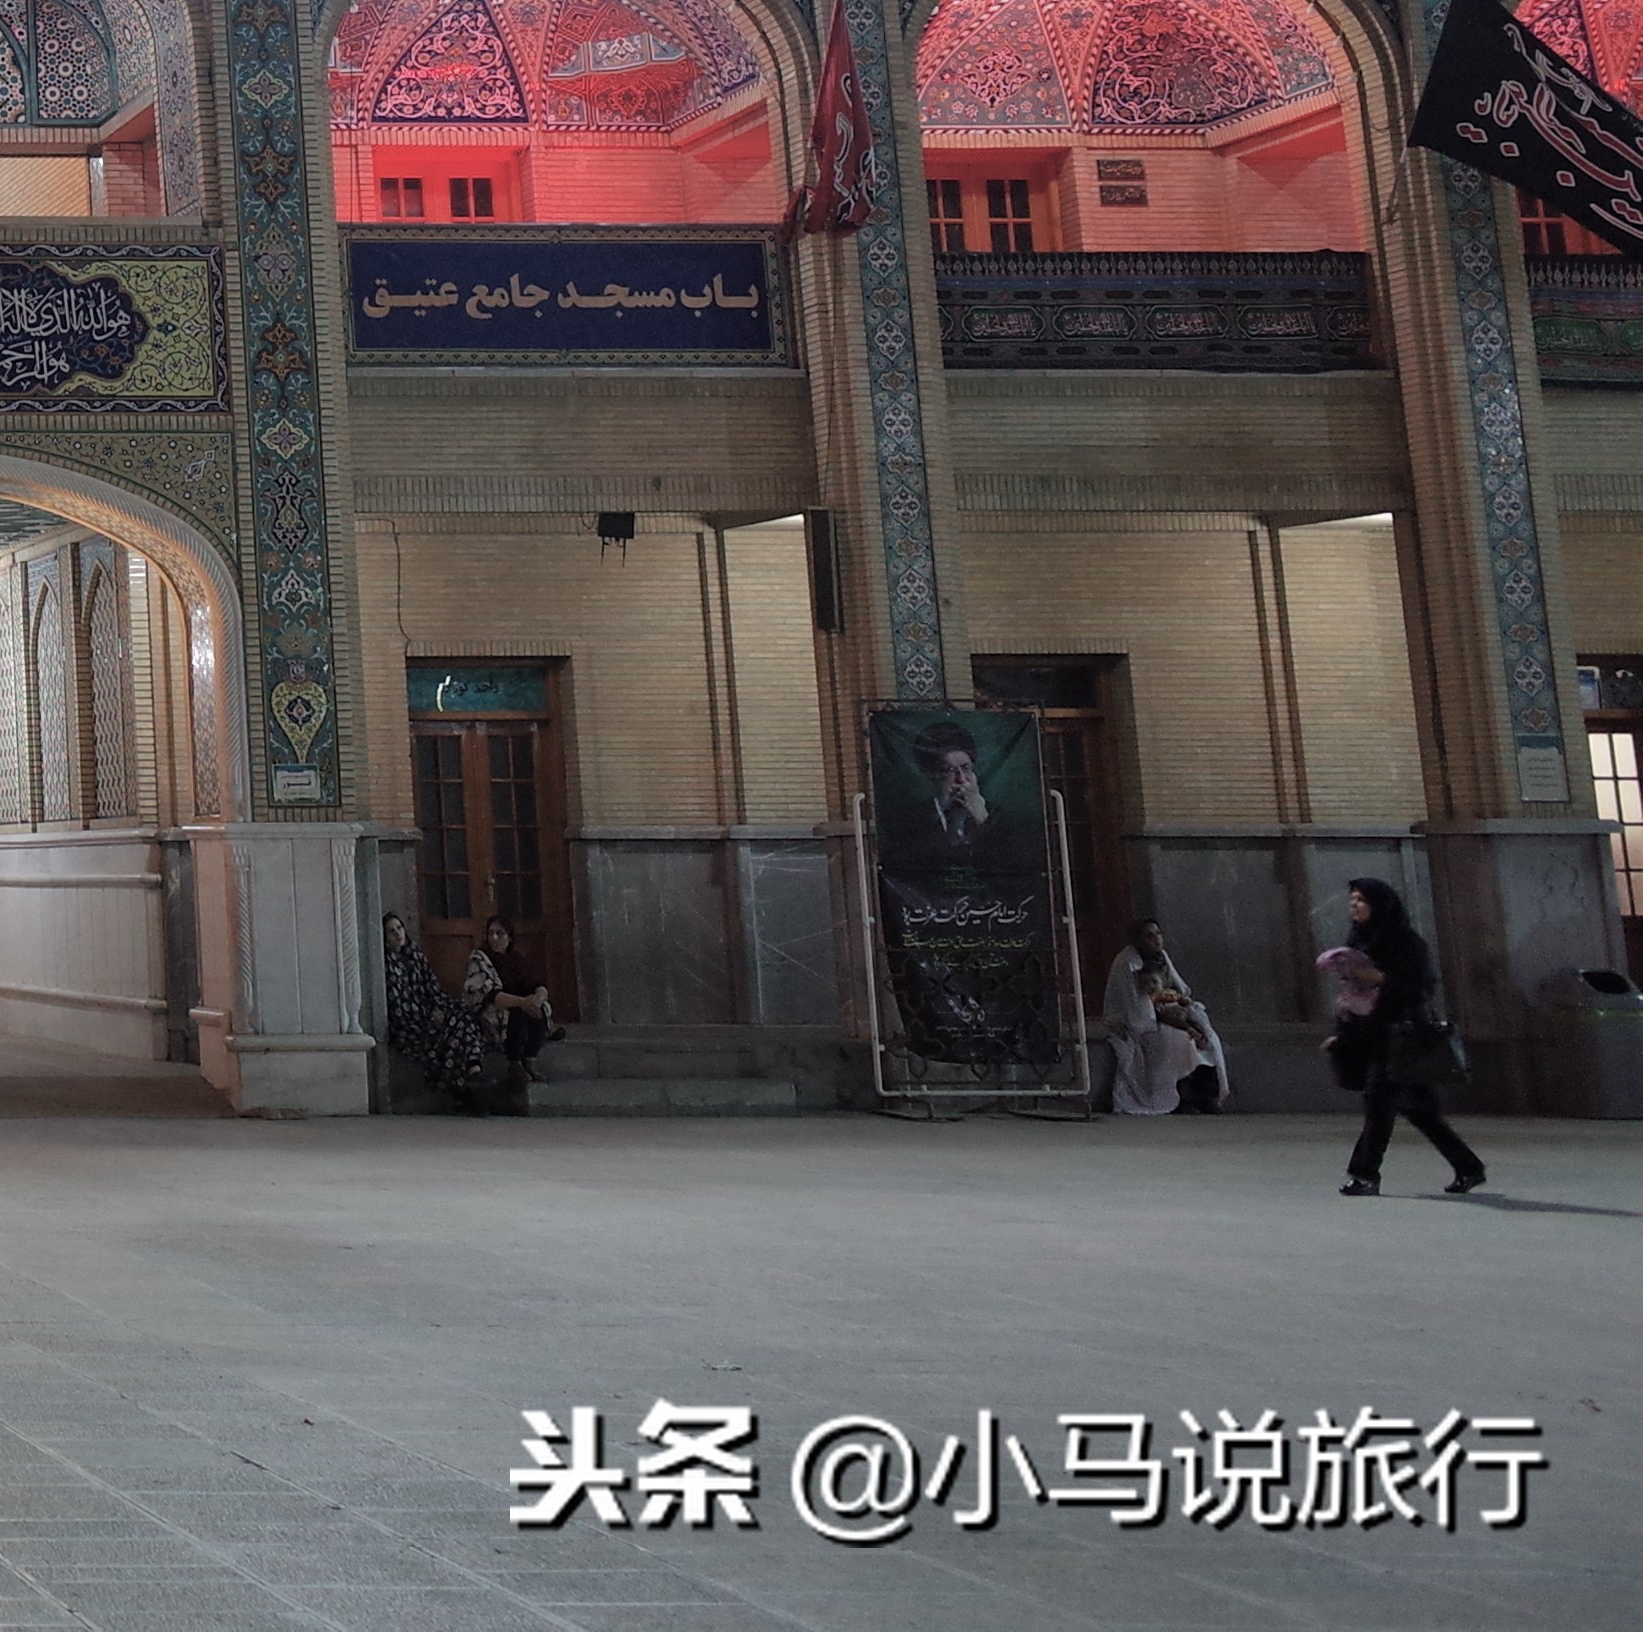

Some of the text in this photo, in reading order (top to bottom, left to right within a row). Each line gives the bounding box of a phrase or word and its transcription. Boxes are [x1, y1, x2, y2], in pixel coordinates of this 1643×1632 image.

[465, 273, 551, 320] جامع
[557, 278, 676, 319] مسجد
[680, 274, 760, 318] باب
